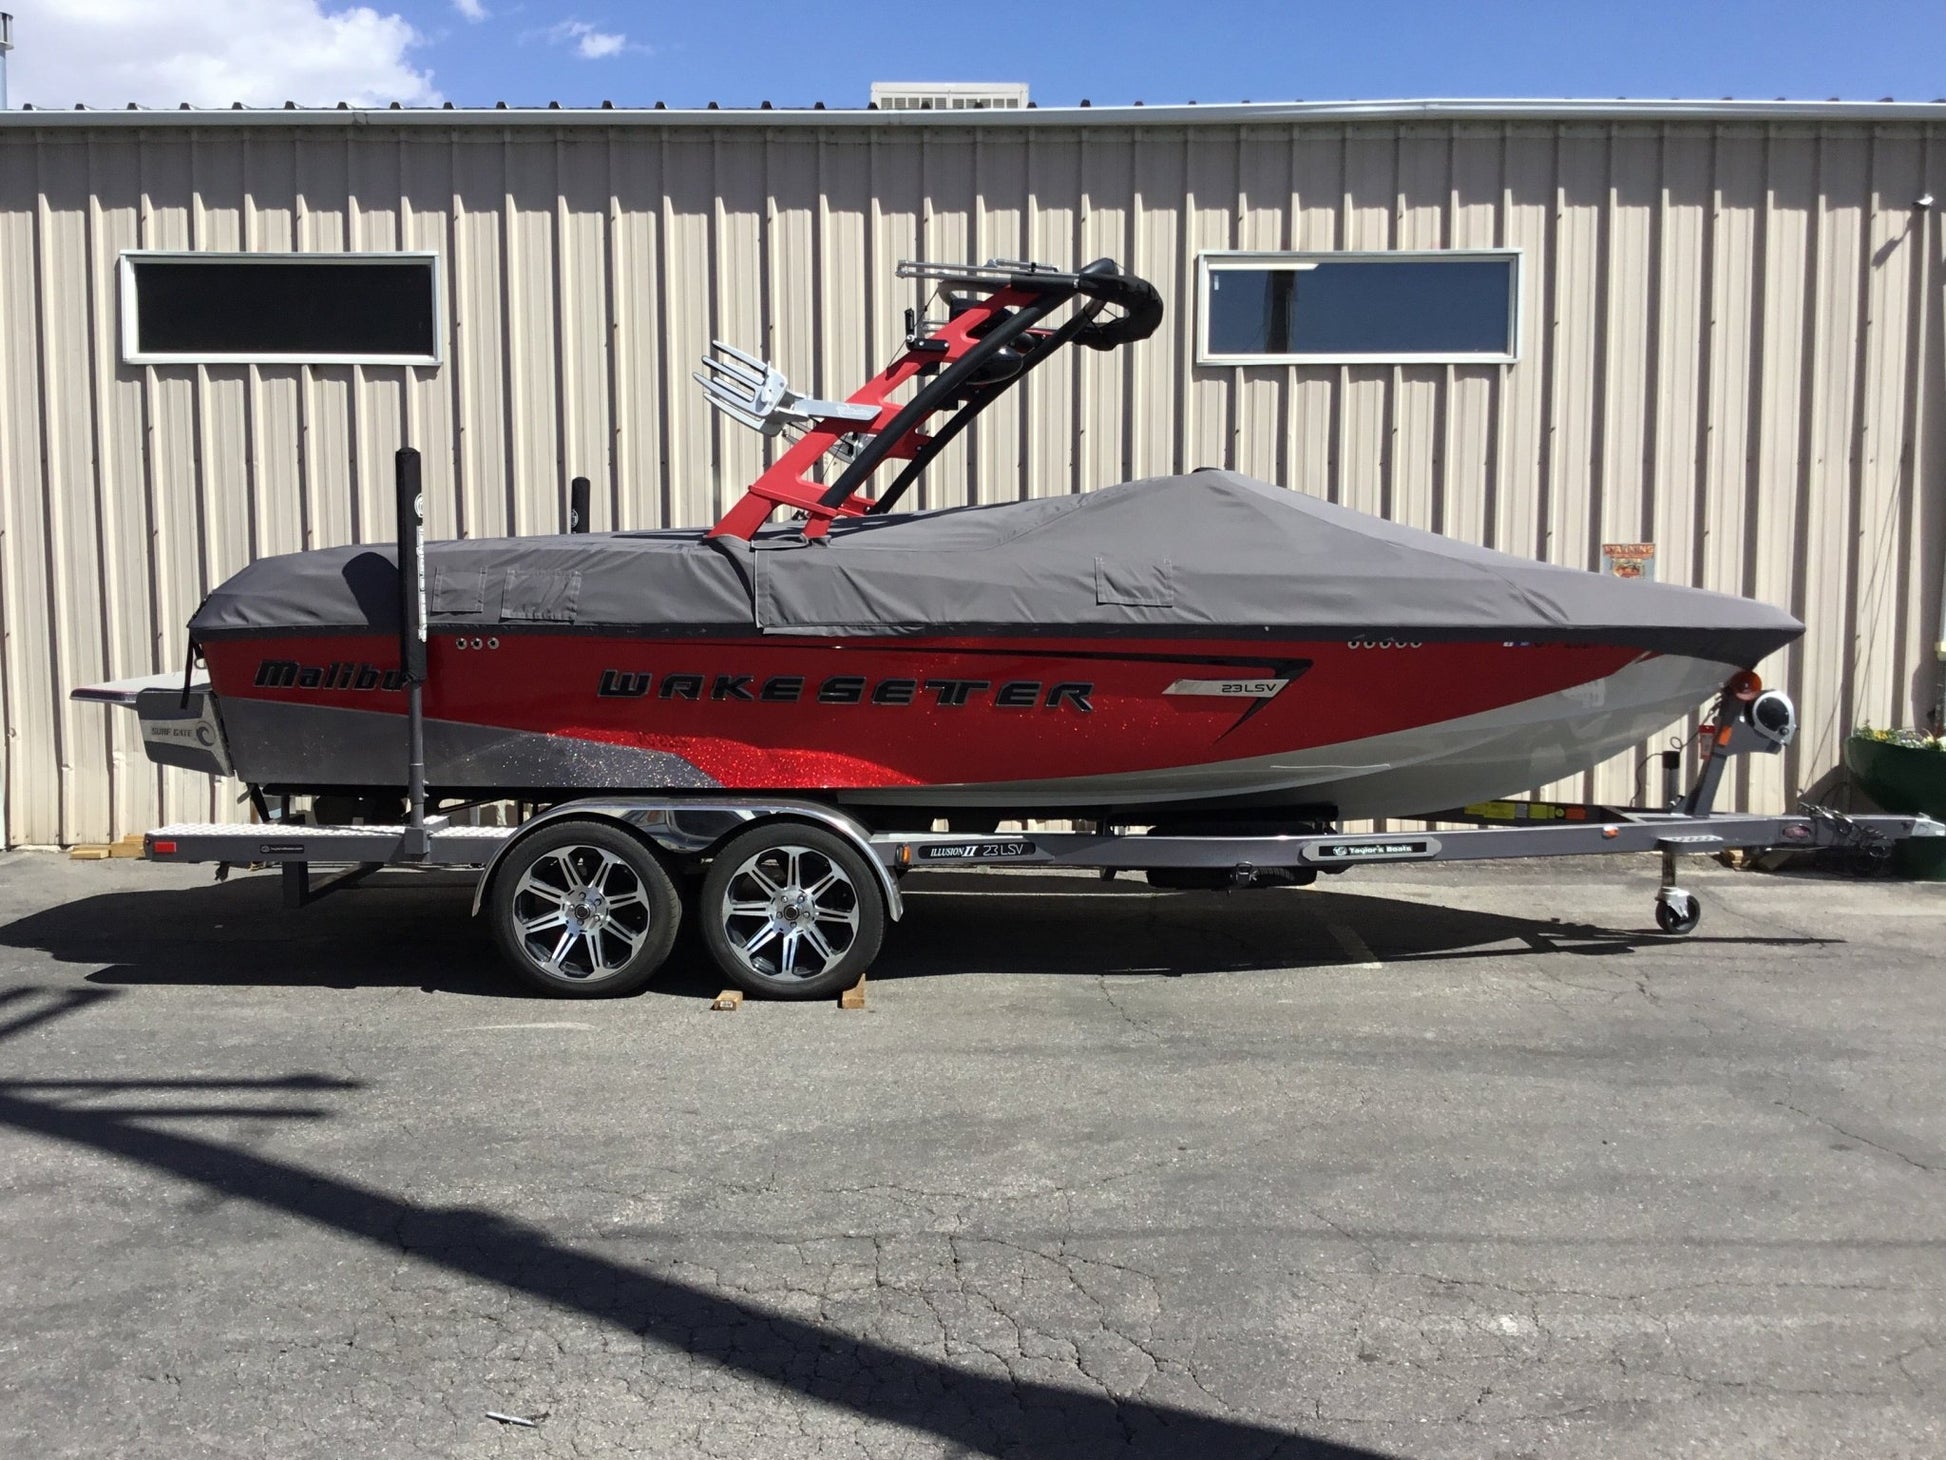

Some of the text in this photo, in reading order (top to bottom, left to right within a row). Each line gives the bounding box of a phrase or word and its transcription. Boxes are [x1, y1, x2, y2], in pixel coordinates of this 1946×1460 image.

[254, 661, 405, 692] Malibu
[151, 727, 192, 737] SURF GATE
[1386, 845, 1412, 853] Boats
